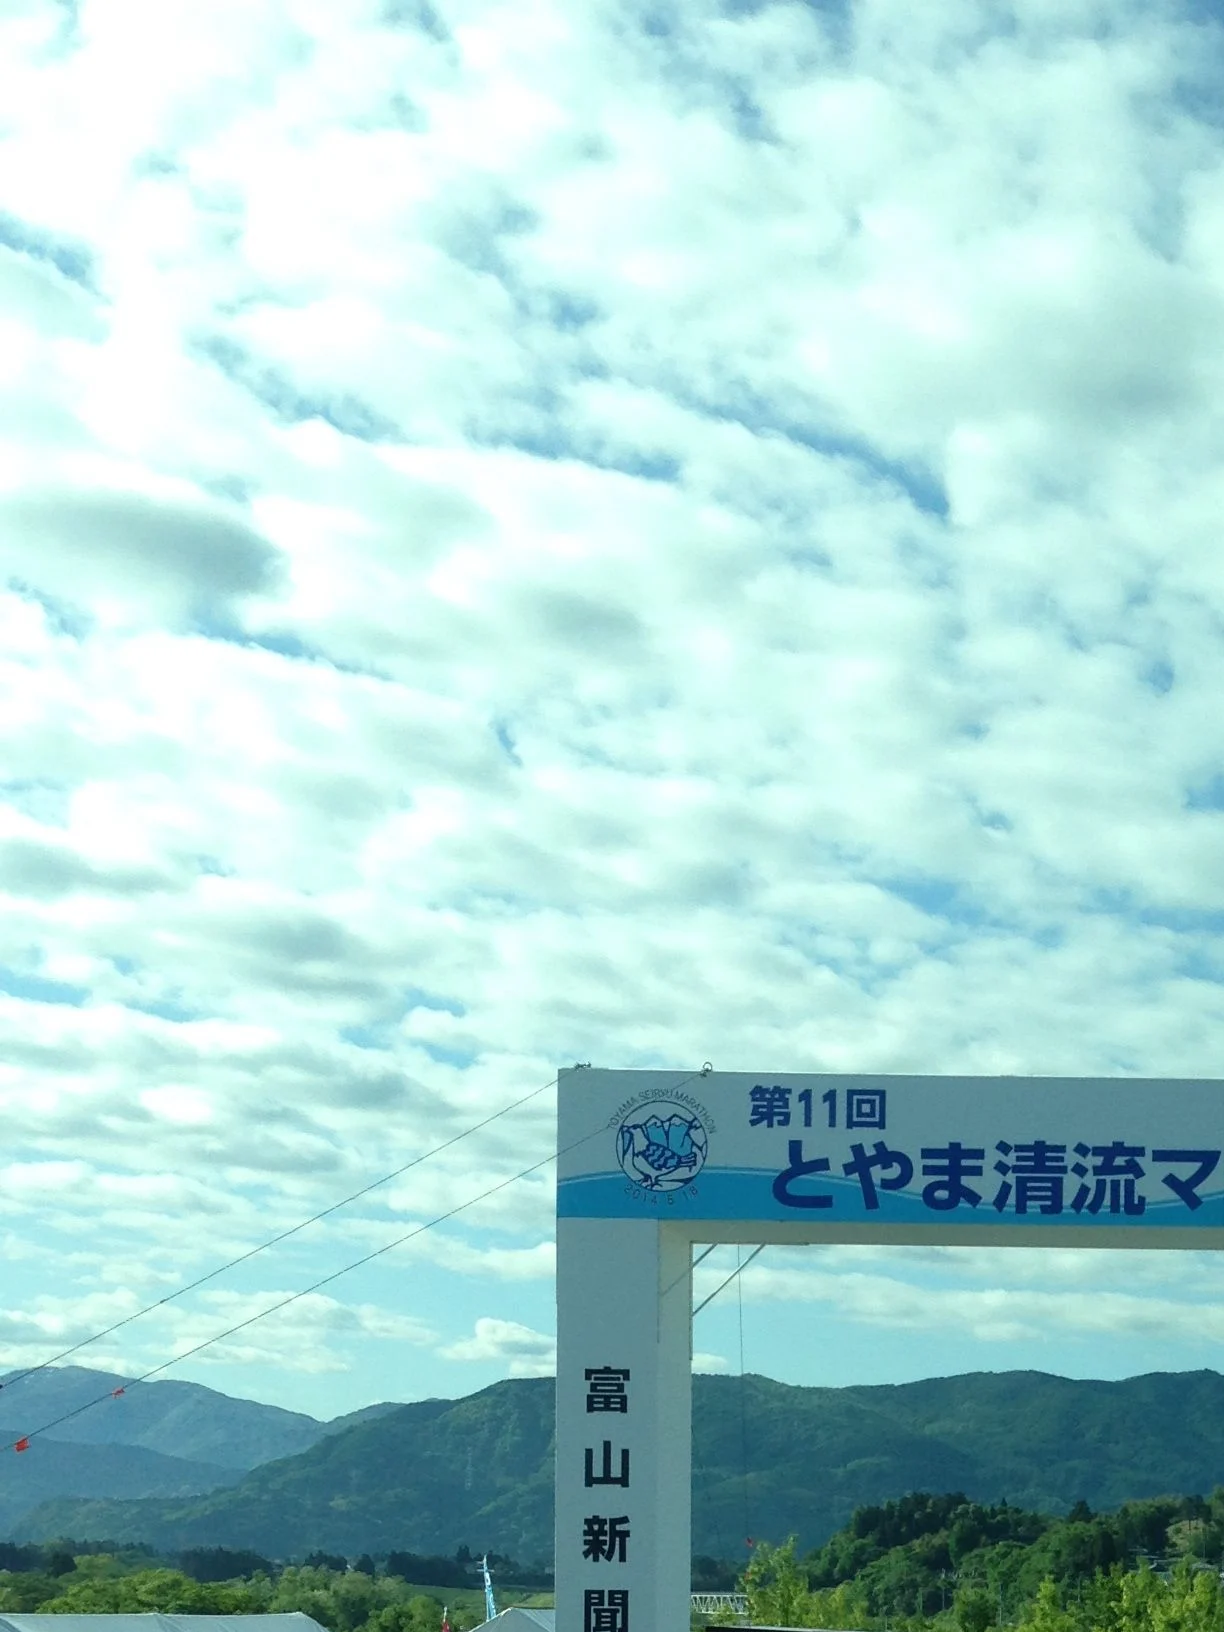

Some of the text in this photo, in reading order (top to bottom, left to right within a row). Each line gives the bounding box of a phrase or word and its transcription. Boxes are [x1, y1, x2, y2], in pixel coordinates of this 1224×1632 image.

[608, 1097, 639, 1129] TOYAMA
[675, 1090, 718, 1135] MARATHON
[749, 1086, 886, 1130] 第11回
